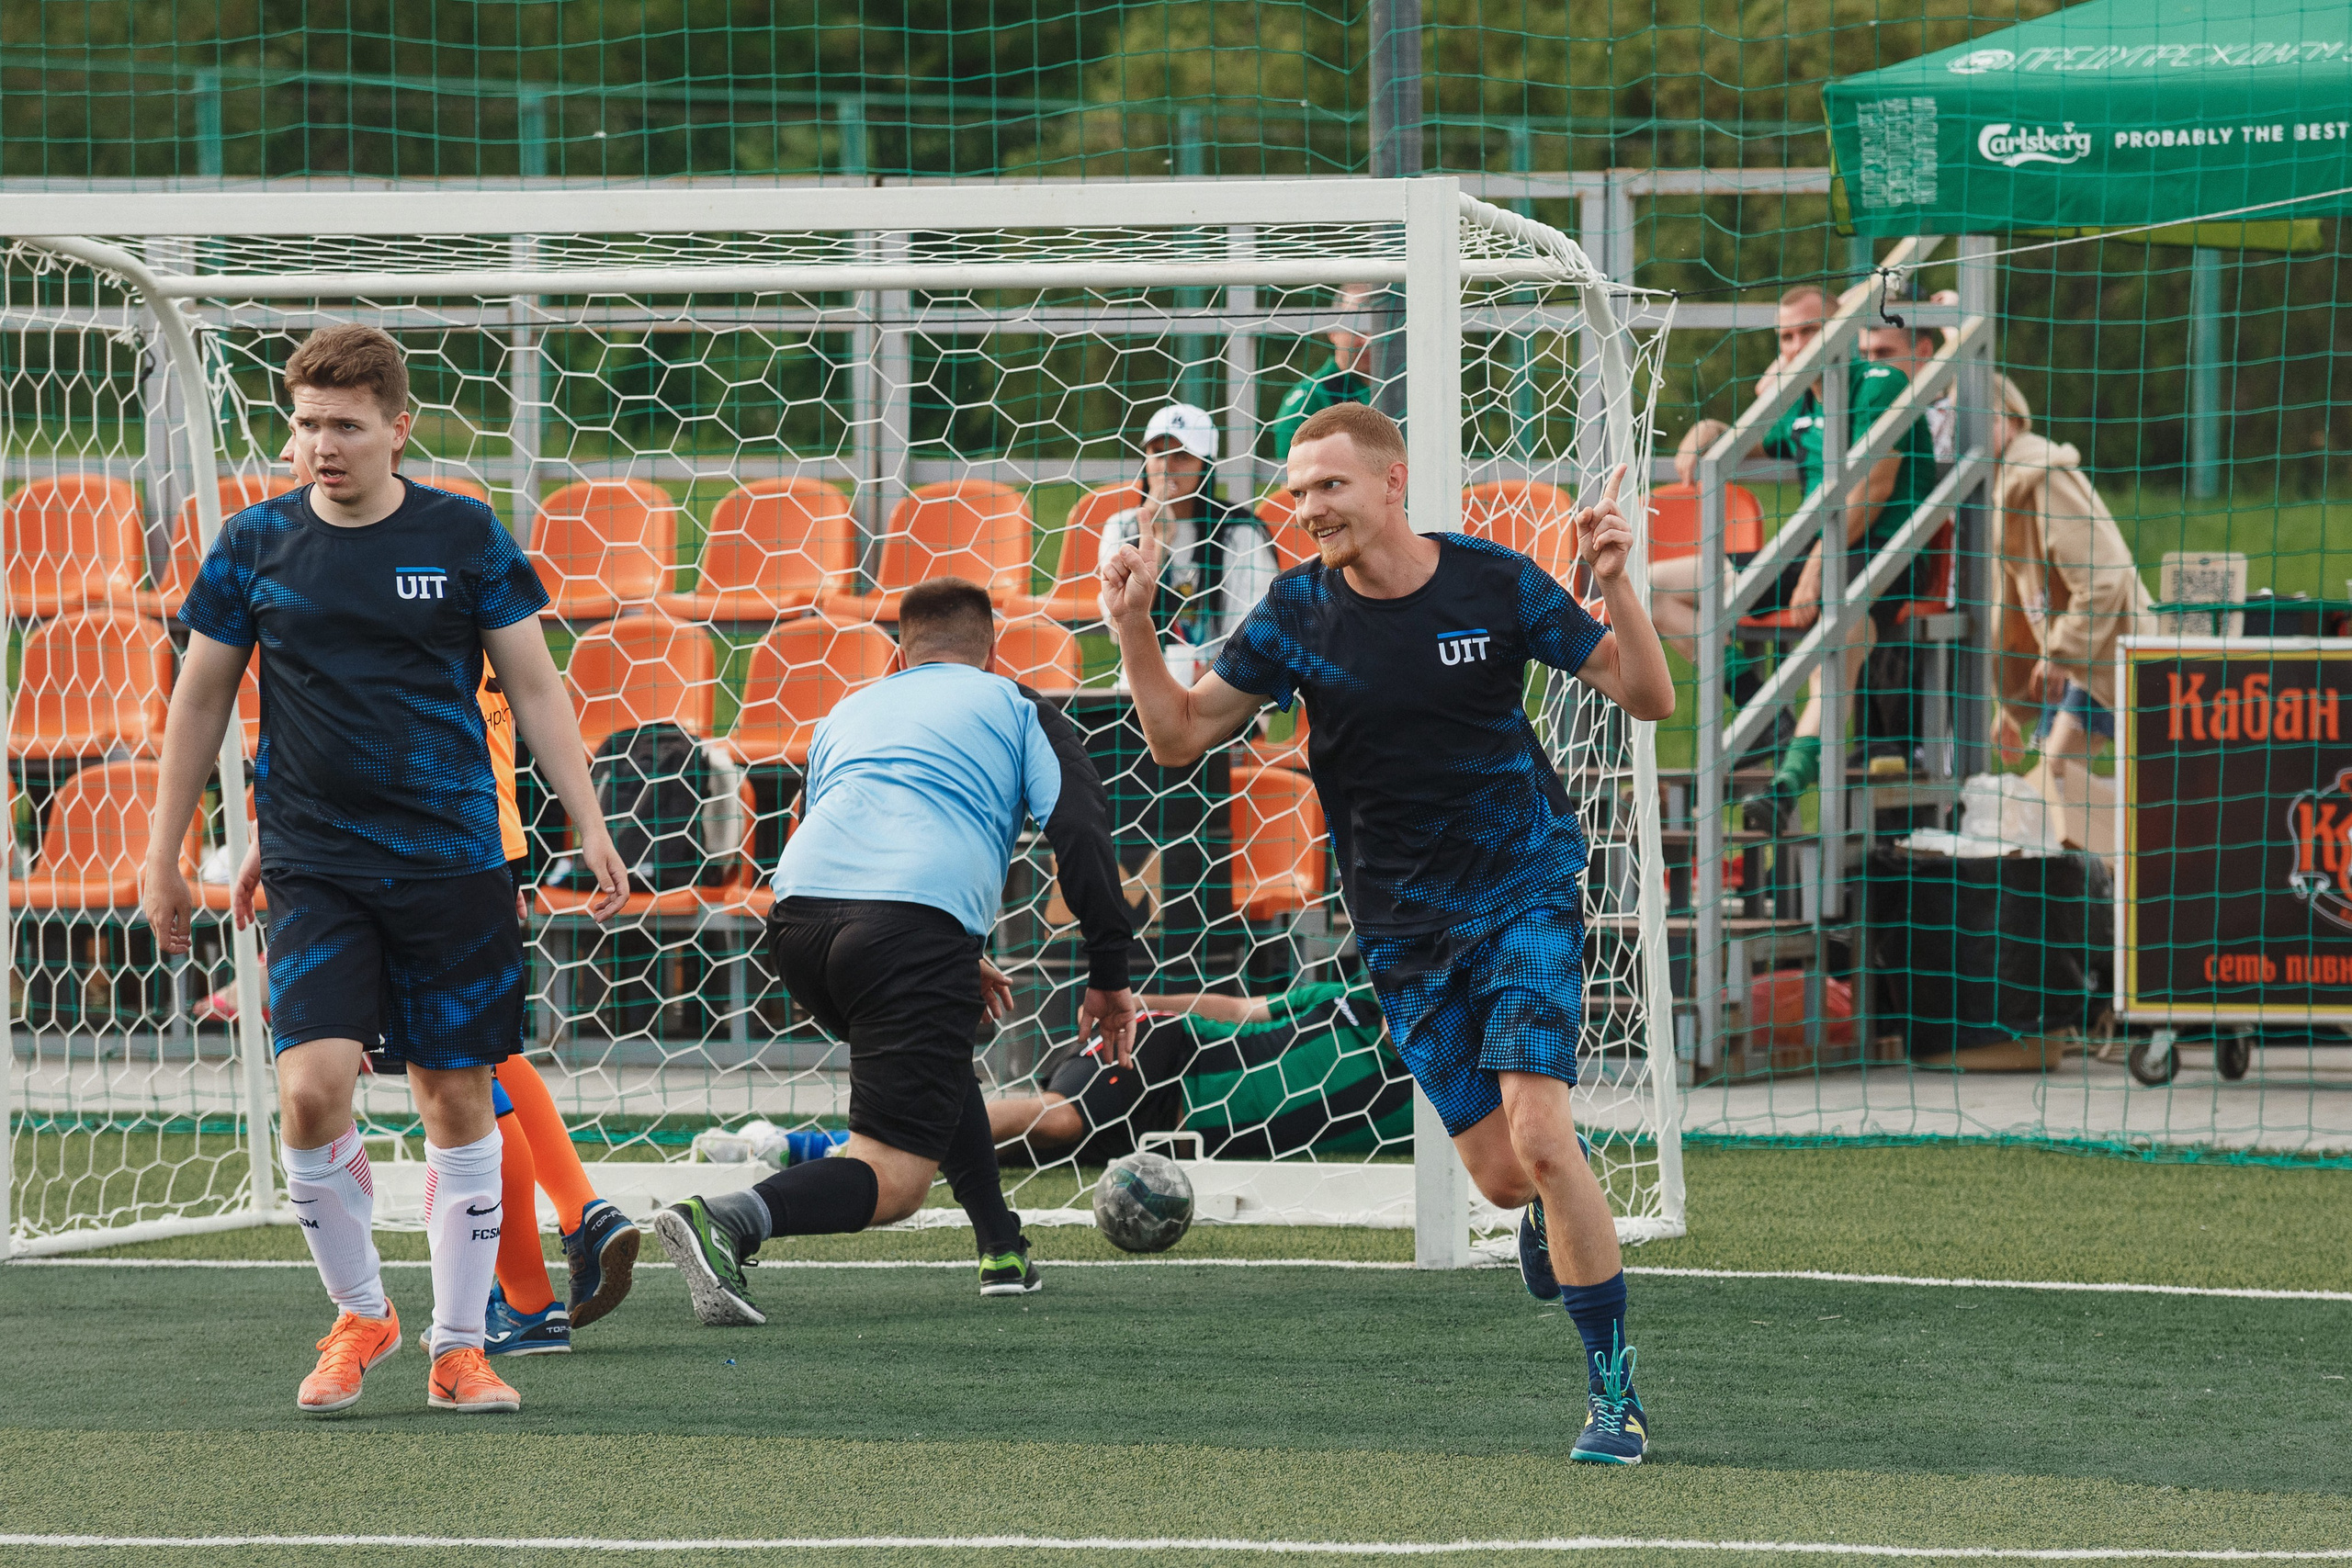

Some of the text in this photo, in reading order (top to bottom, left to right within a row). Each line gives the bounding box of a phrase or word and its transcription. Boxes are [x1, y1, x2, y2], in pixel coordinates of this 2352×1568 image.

[1978, 120, 2350, 165] Carlsberg PROBABLY THE BEST
[396, 576, 447, 599] UIT
[1438, 637, 1490, 666] UIT
[2166, 671, 2340, 740] Кабан
